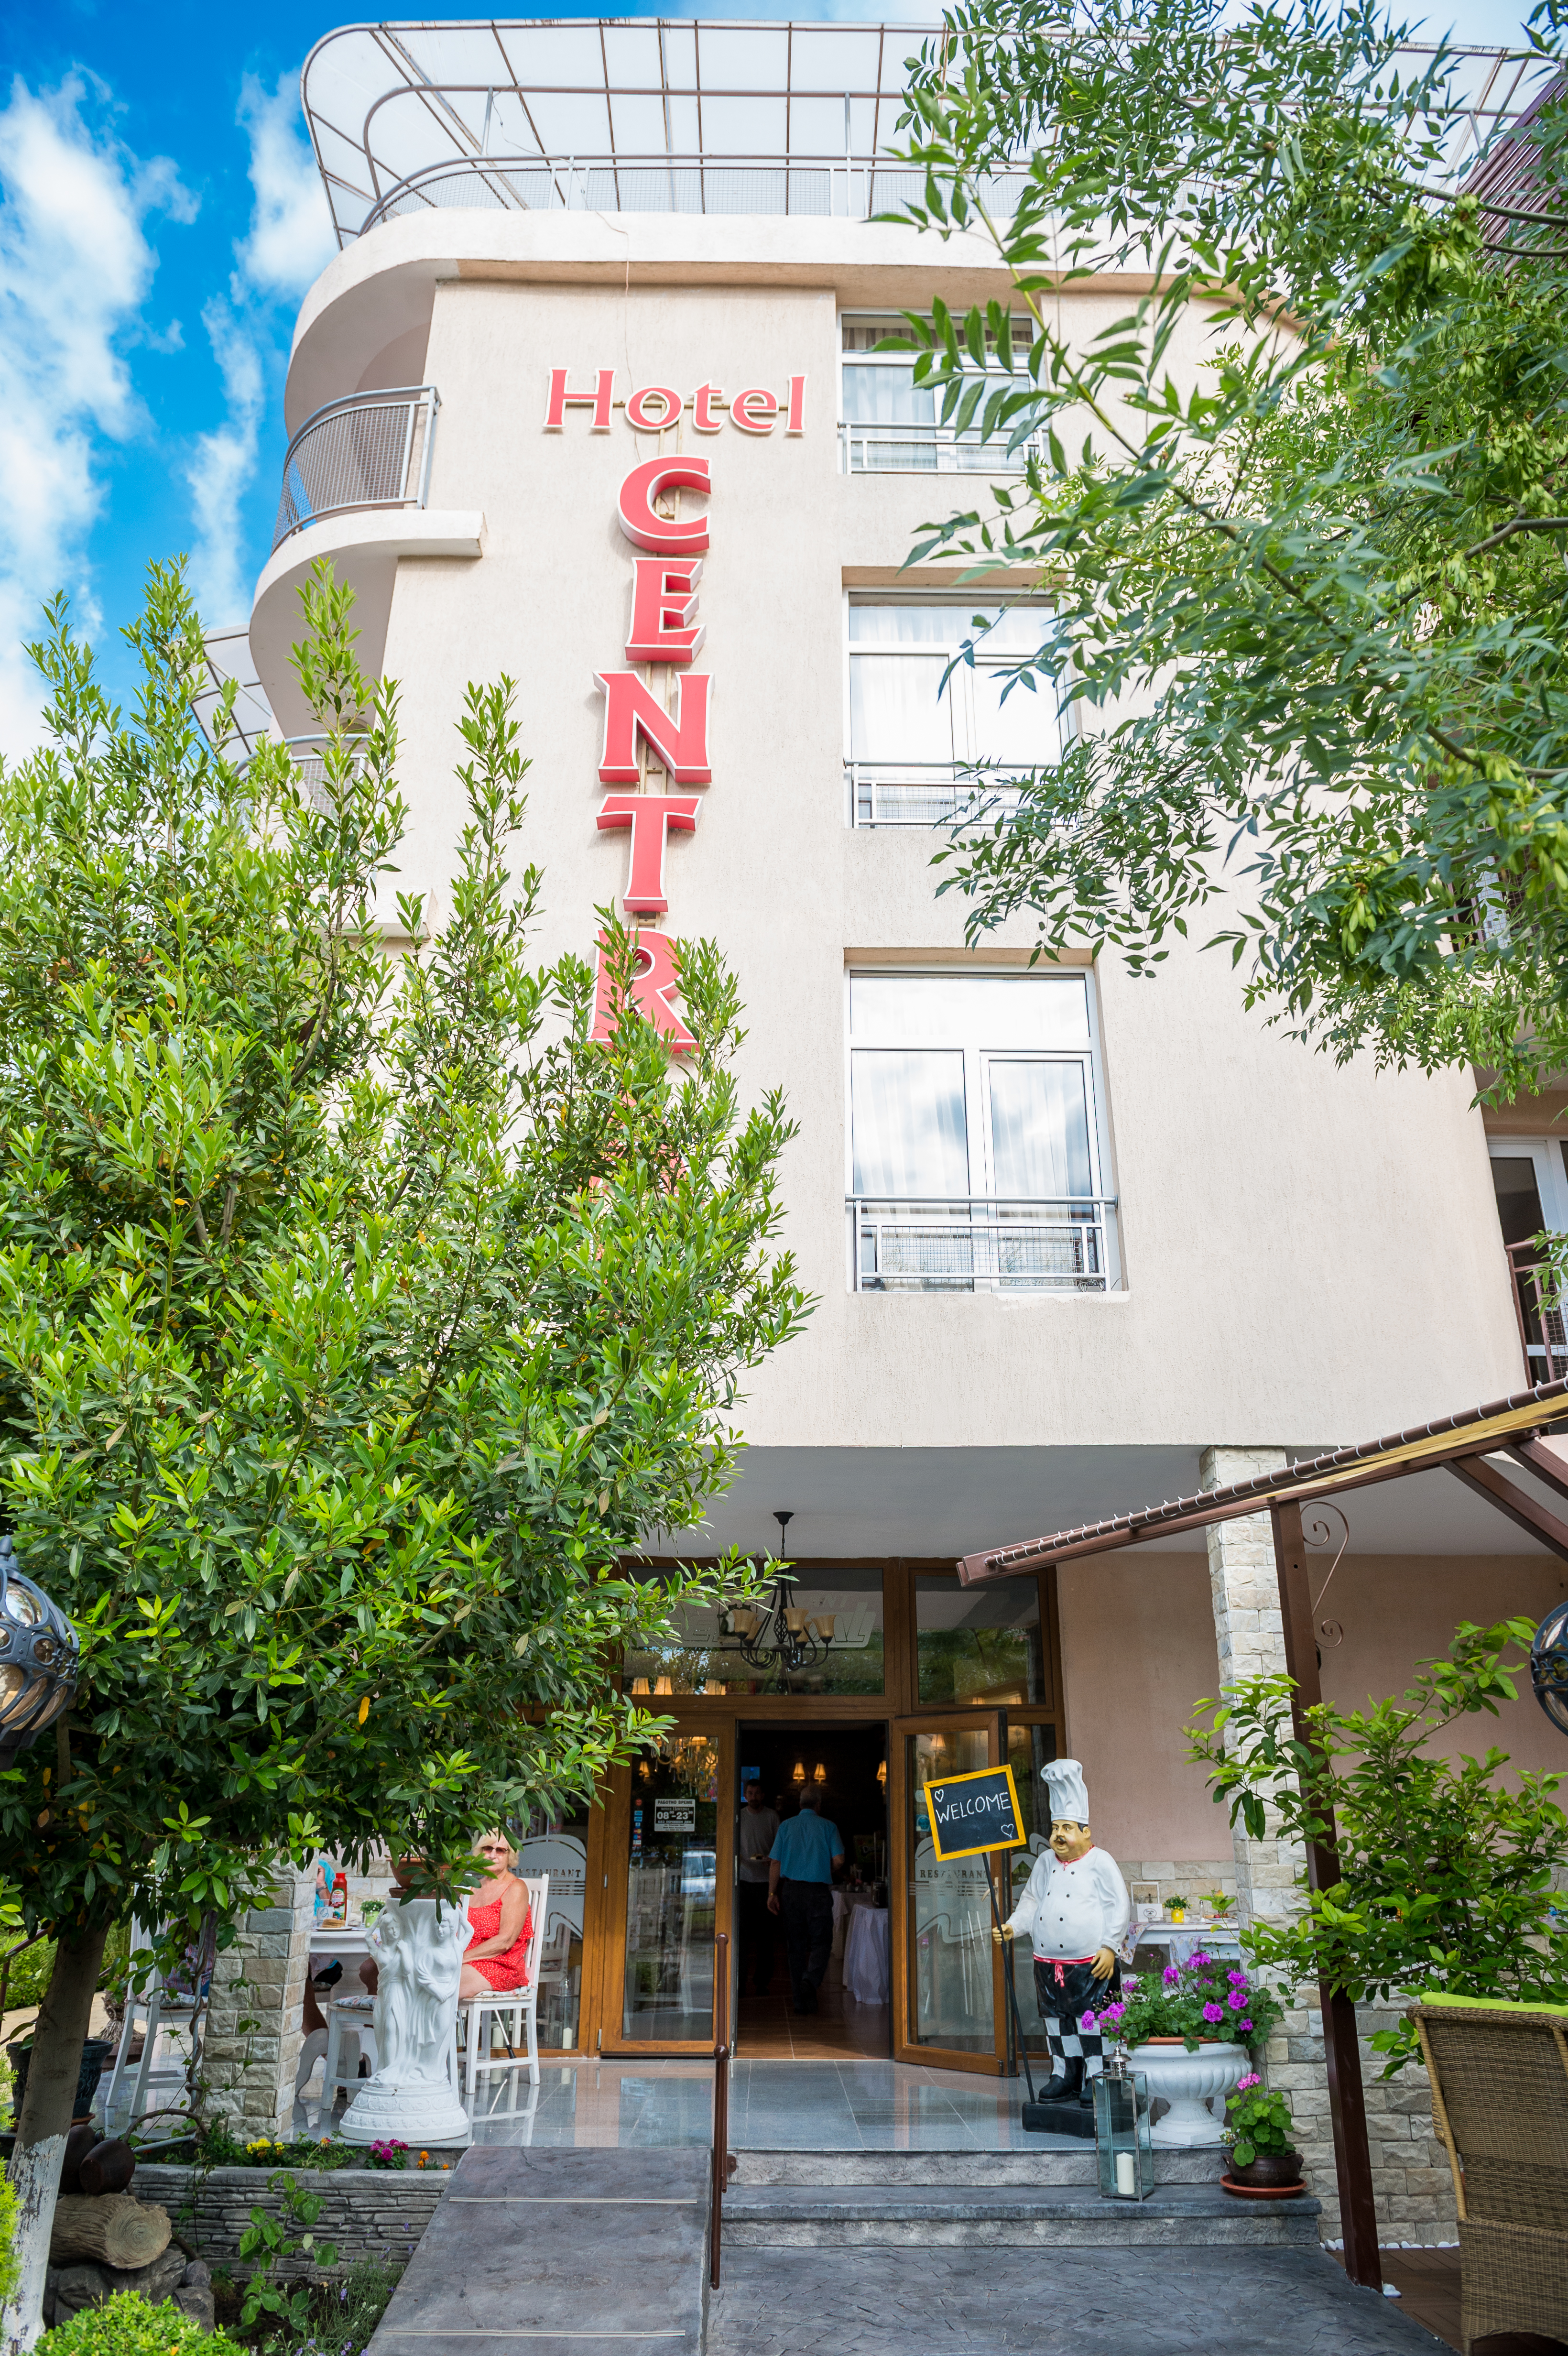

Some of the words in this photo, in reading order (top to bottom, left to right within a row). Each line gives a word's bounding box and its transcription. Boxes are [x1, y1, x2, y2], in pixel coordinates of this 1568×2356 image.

[542, 367, 808, 433] Hotel
[578, 454, 716, 1210] CENTR
[935, 1791, 1012, 1824] WELCOME
